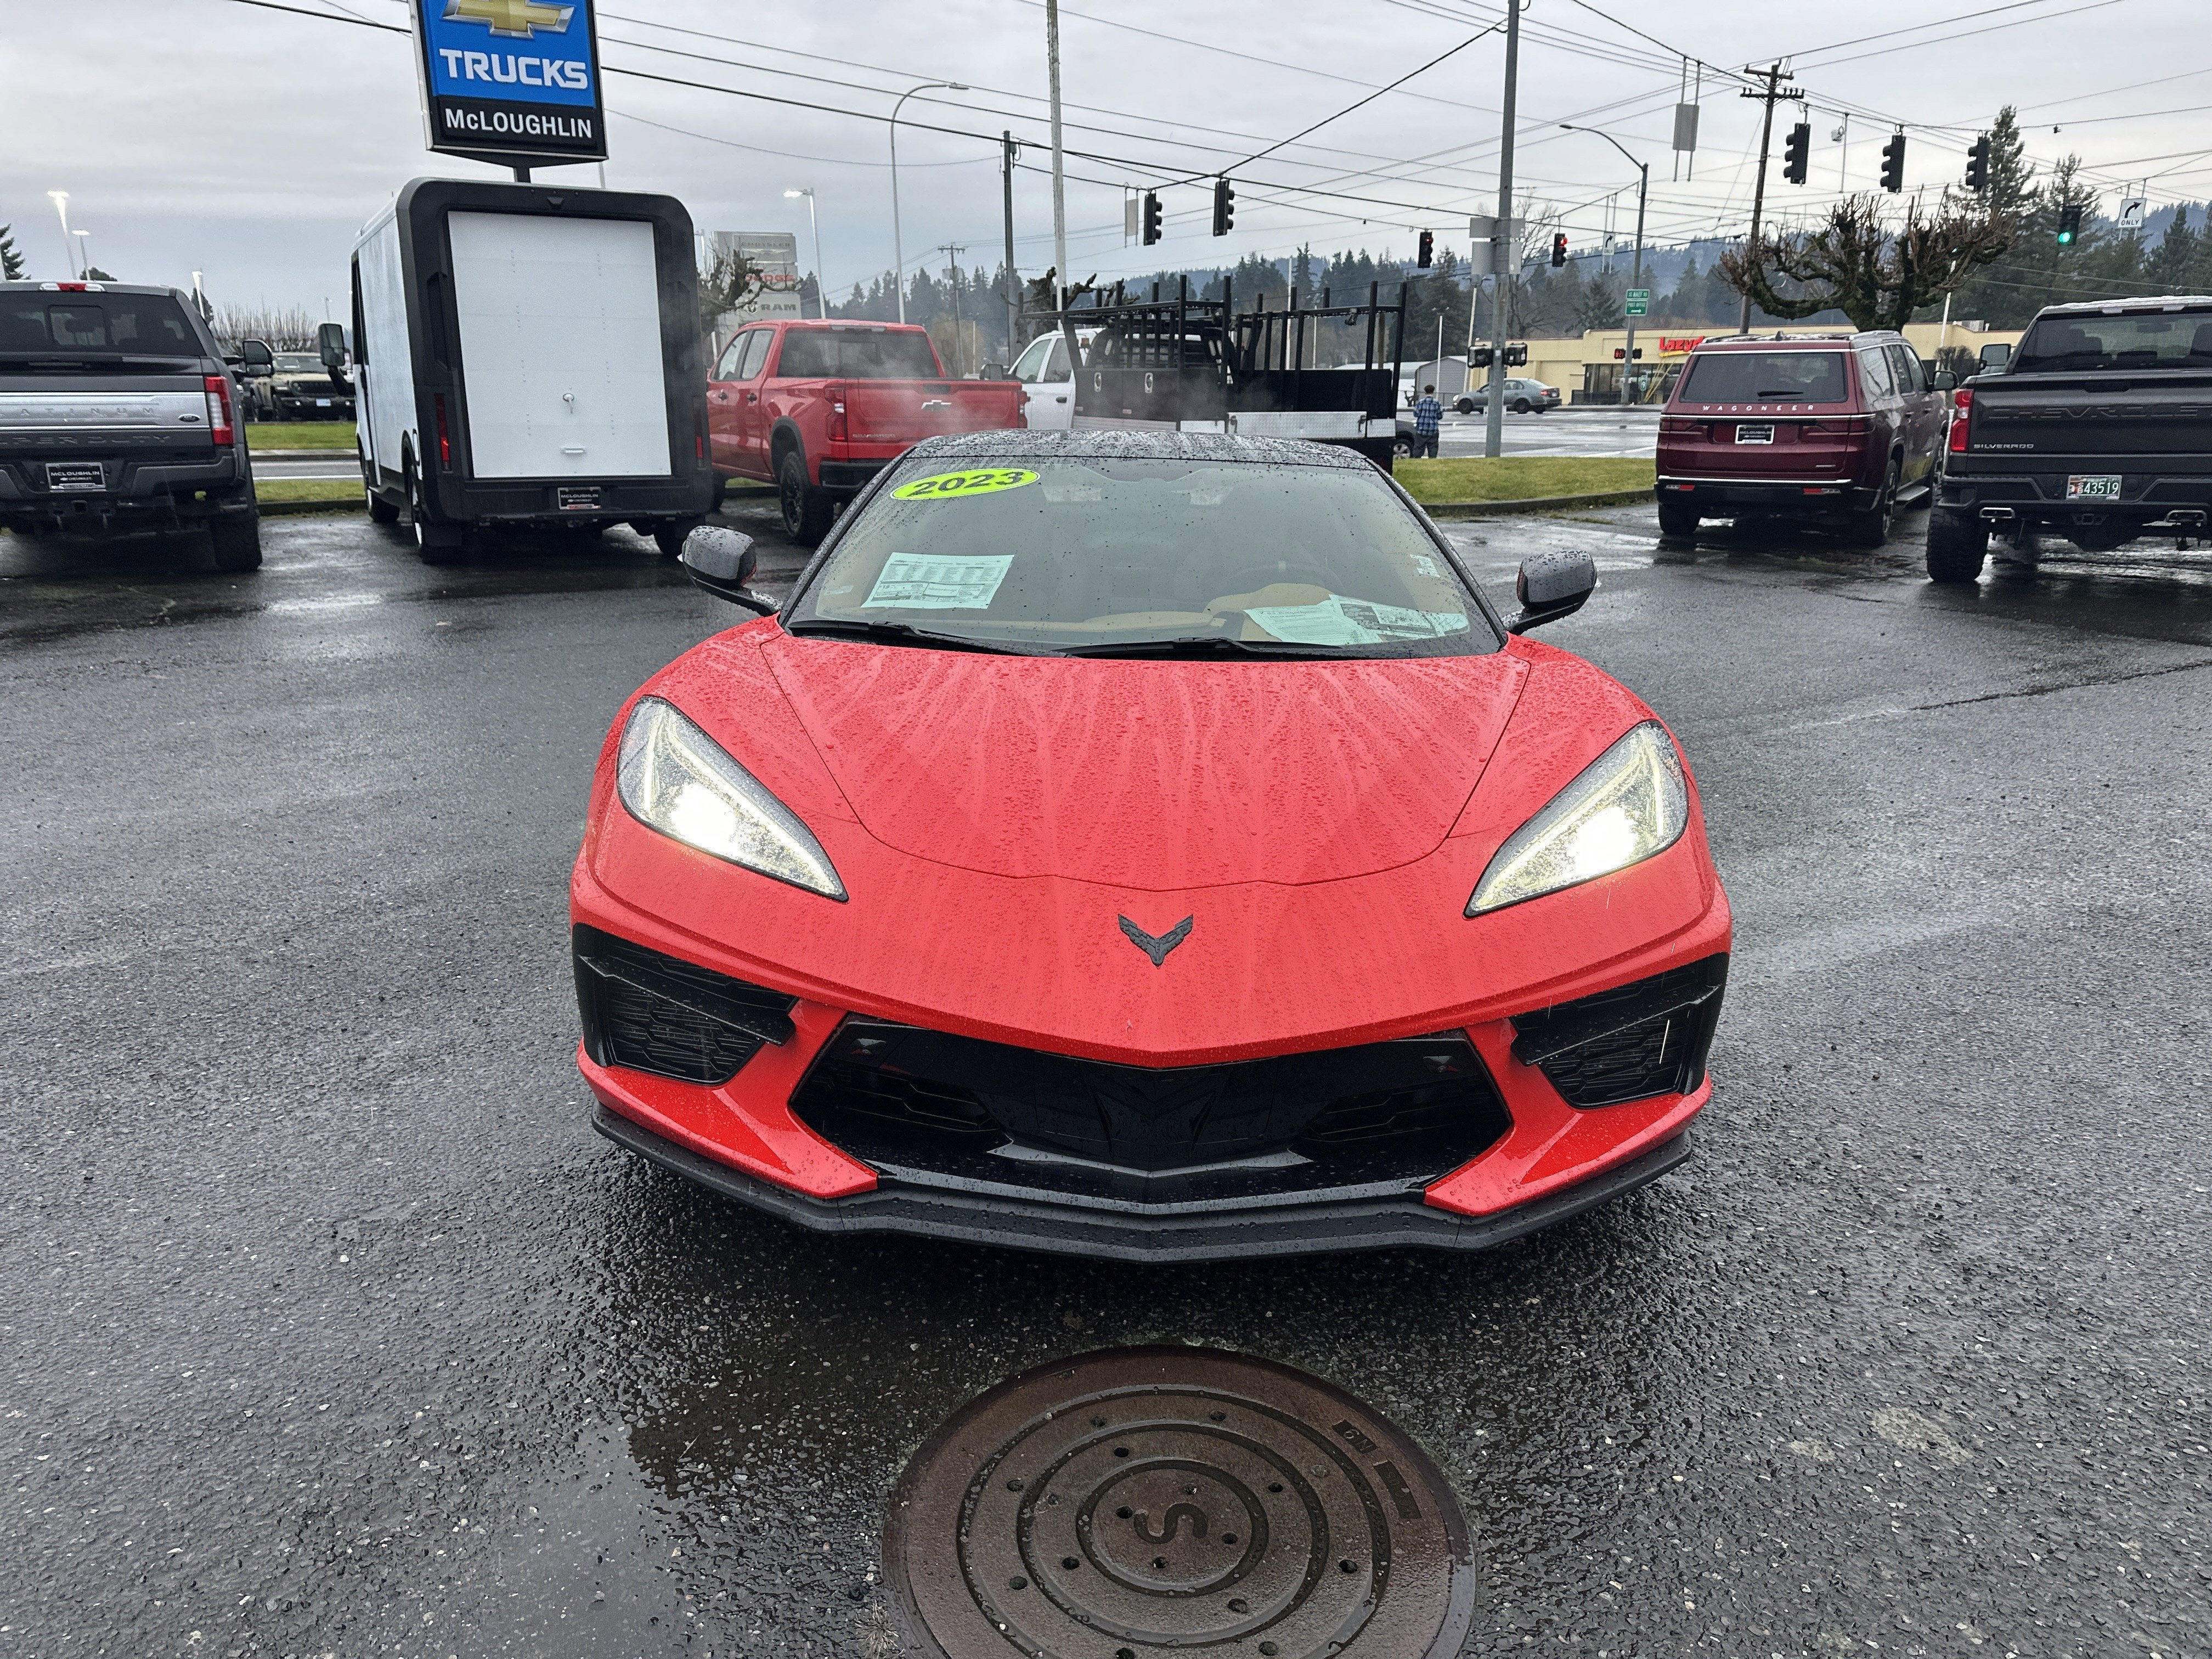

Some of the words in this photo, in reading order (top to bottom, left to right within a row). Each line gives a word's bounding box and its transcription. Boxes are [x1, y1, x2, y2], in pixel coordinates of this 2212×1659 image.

[439, 48, 588, 89] TRUCKS
[445, 108, 592, 138] McLOUGHLIN
[88, 436, 170, 444] DUTY
[906, 471, 1025, 497] 2023
[2084, 482, 2119, 494] 43519
